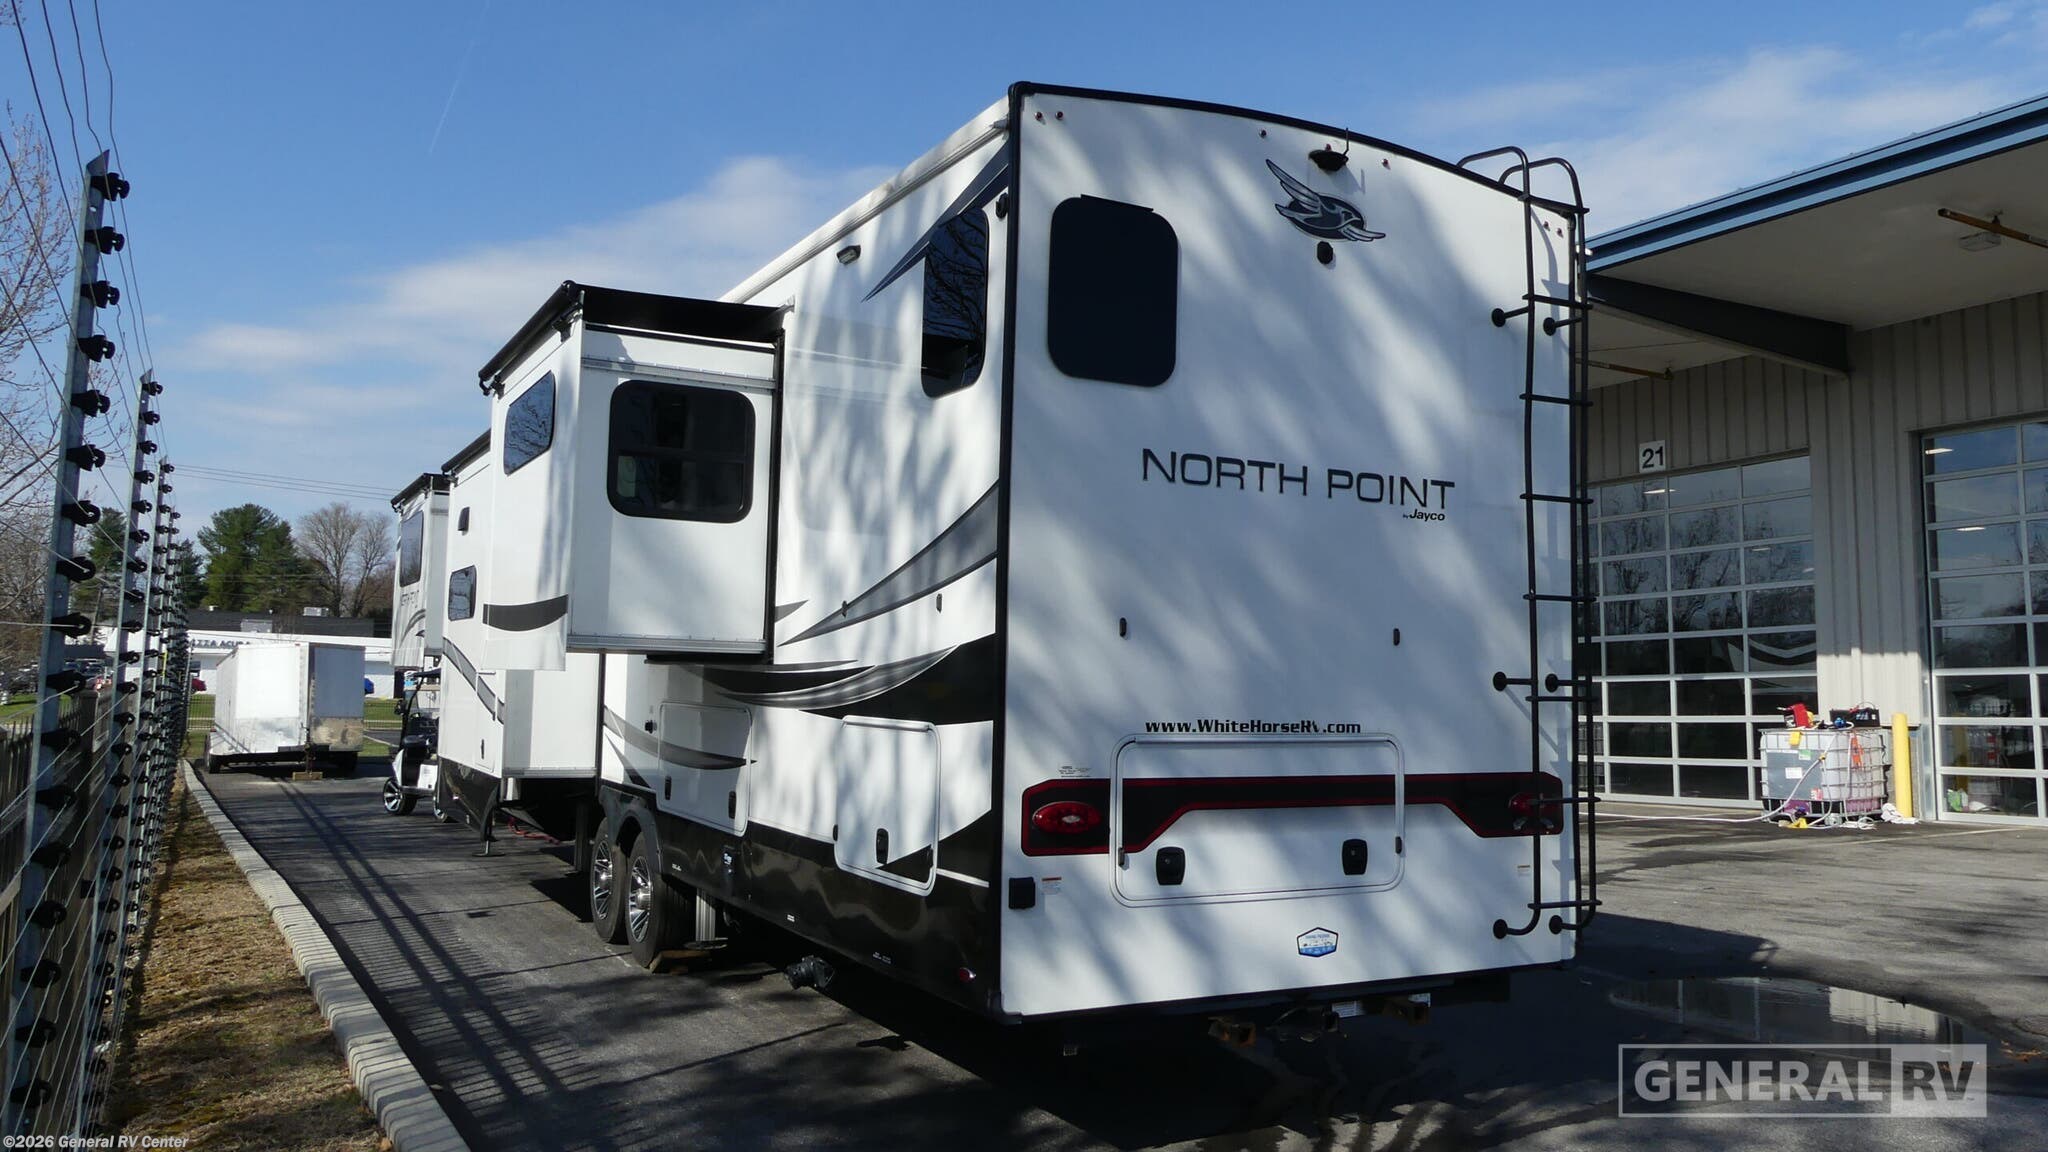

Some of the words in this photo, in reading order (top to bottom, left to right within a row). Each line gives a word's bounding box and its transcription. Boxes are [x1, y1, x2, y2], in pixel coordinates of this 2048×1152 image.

[1642, 446, 1664, 469] 21
[1143, 448, 1308, 497] NORTH
[1327, 468, 1455, 510] POINT
[1409, 508, 1446, 522] Jayco
